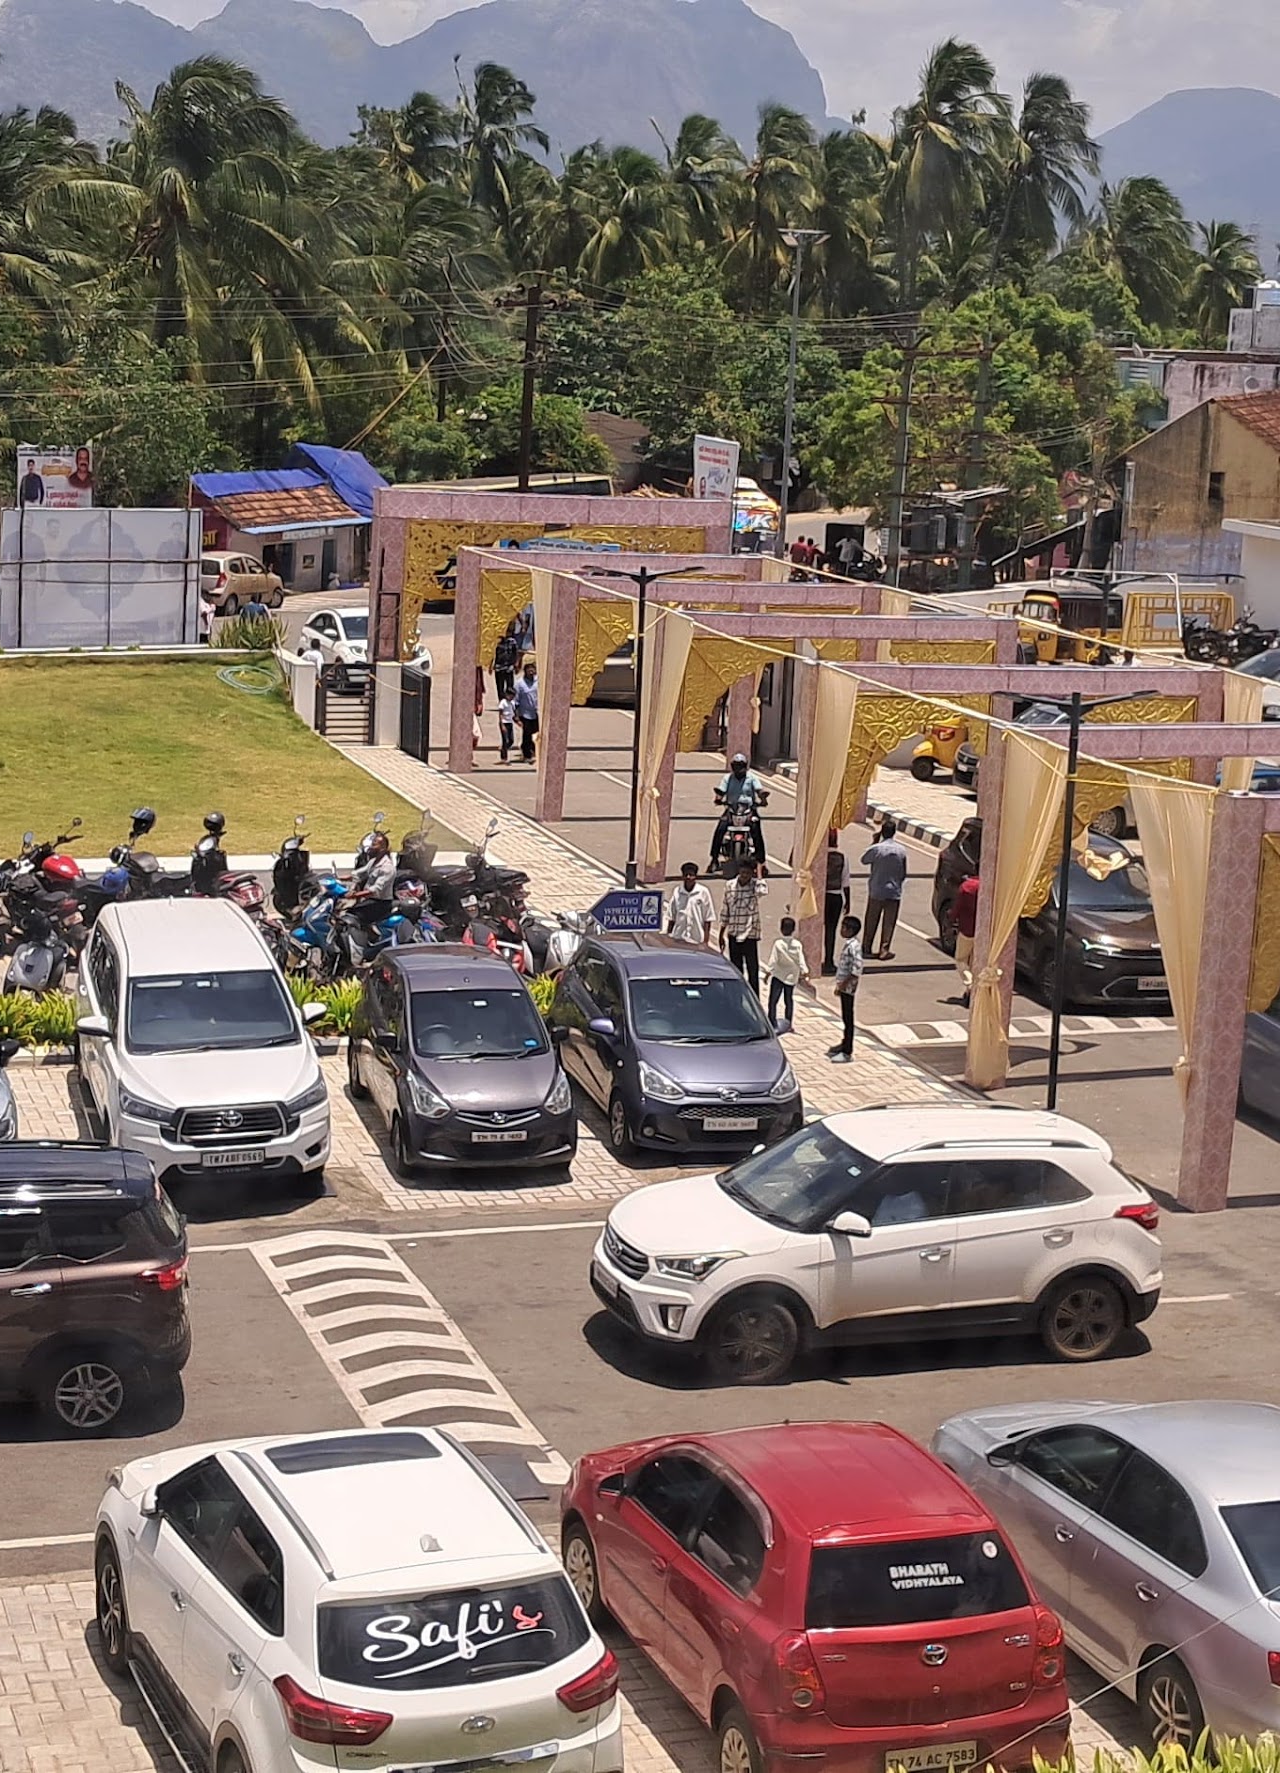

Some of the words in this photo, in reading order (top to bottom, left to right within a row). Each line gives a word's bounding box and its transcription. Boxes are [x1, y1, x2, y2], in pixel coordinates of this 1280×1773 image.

[620, 897, 639, 906] TWO
[604, 914, 658, 925] PARKING
[888, 1562, 950, 1579] BHARATH
[892, 1576, 965, 1590] VIDHYALAYA
[363, 1600, 544, 1660] Safi's
[908, 1756, 922, 1769] 74
[926, 1753, 943, 1765] AC
[946, 1748, 975, 1763] 7583
